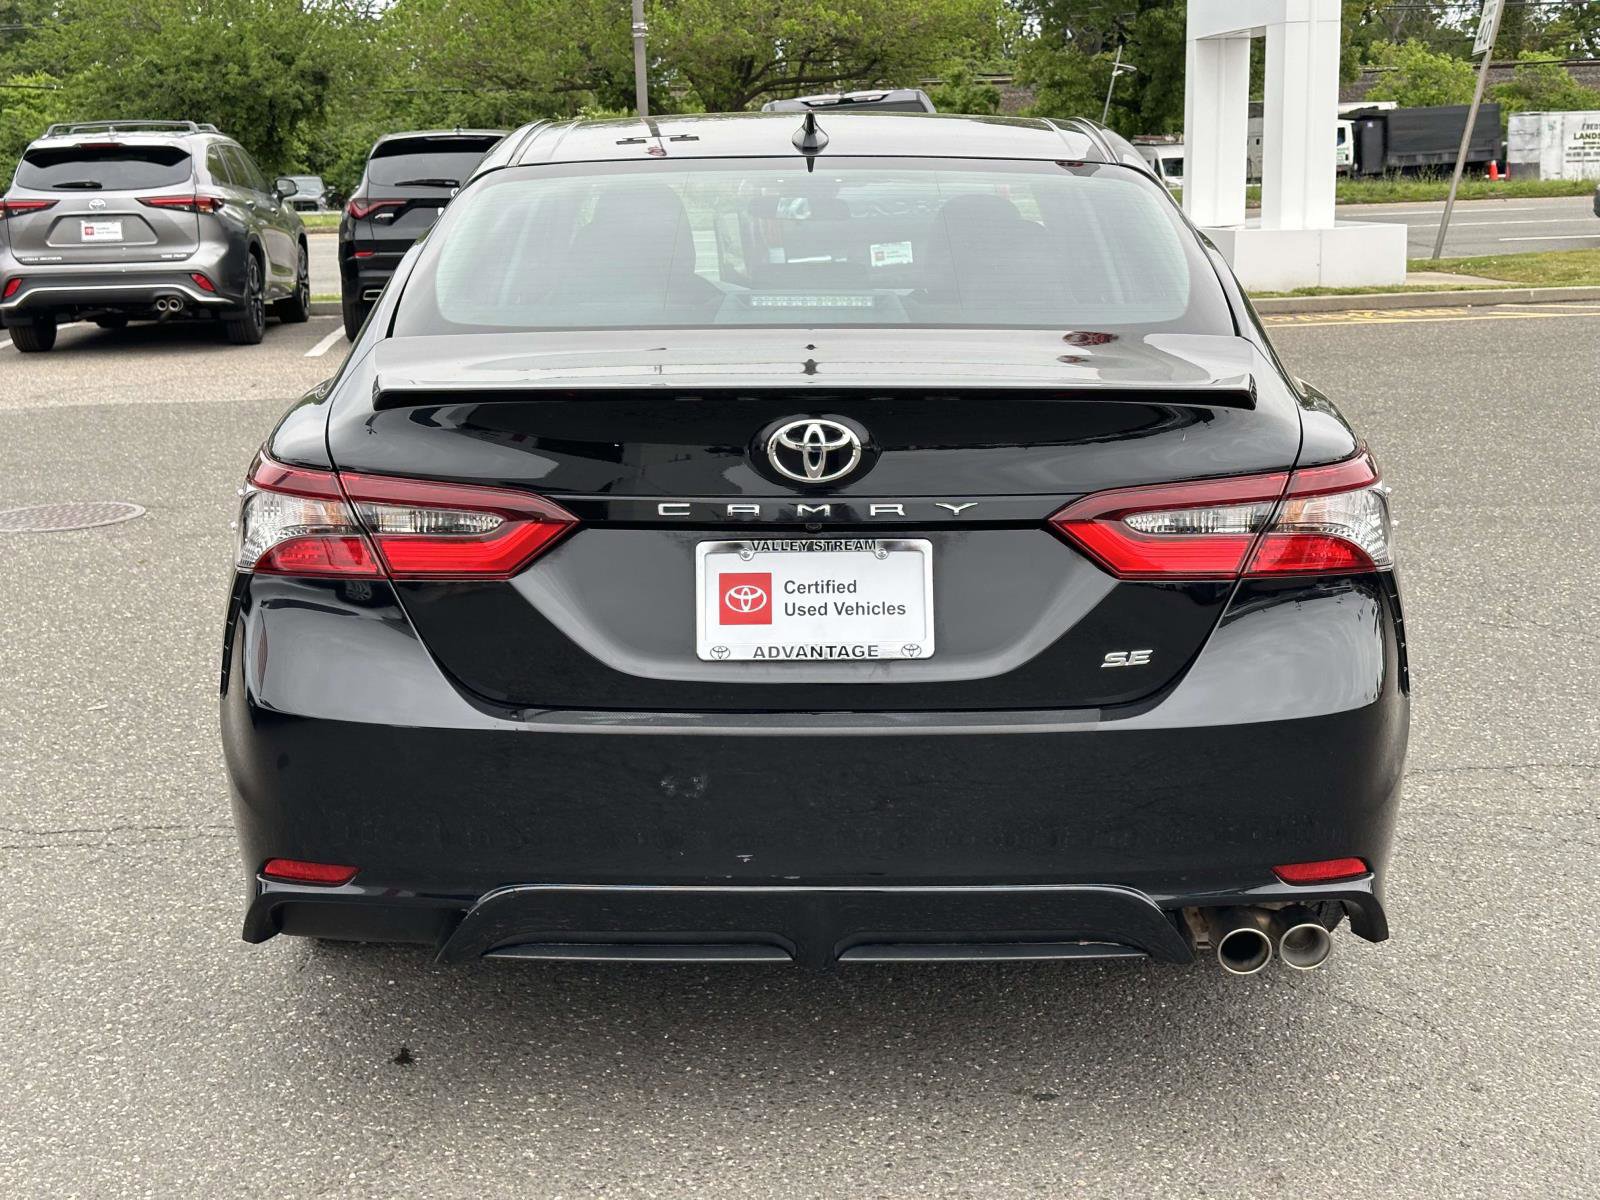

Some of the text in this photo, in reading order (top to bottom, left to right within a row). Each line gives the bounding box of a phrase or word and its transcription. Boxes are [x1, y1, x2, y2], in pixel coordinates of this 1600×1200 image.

[657, 502, 978, 516] CAMRY
[752, 540, 877, 551] VALLEY STREAM
[784, 580, 857, 594] Certified
[784, 601, 906, 616] Used Vehicles
[753, 645, 879, 659] ADVANTAGE
[1101, 649, 1153, 667] SE
